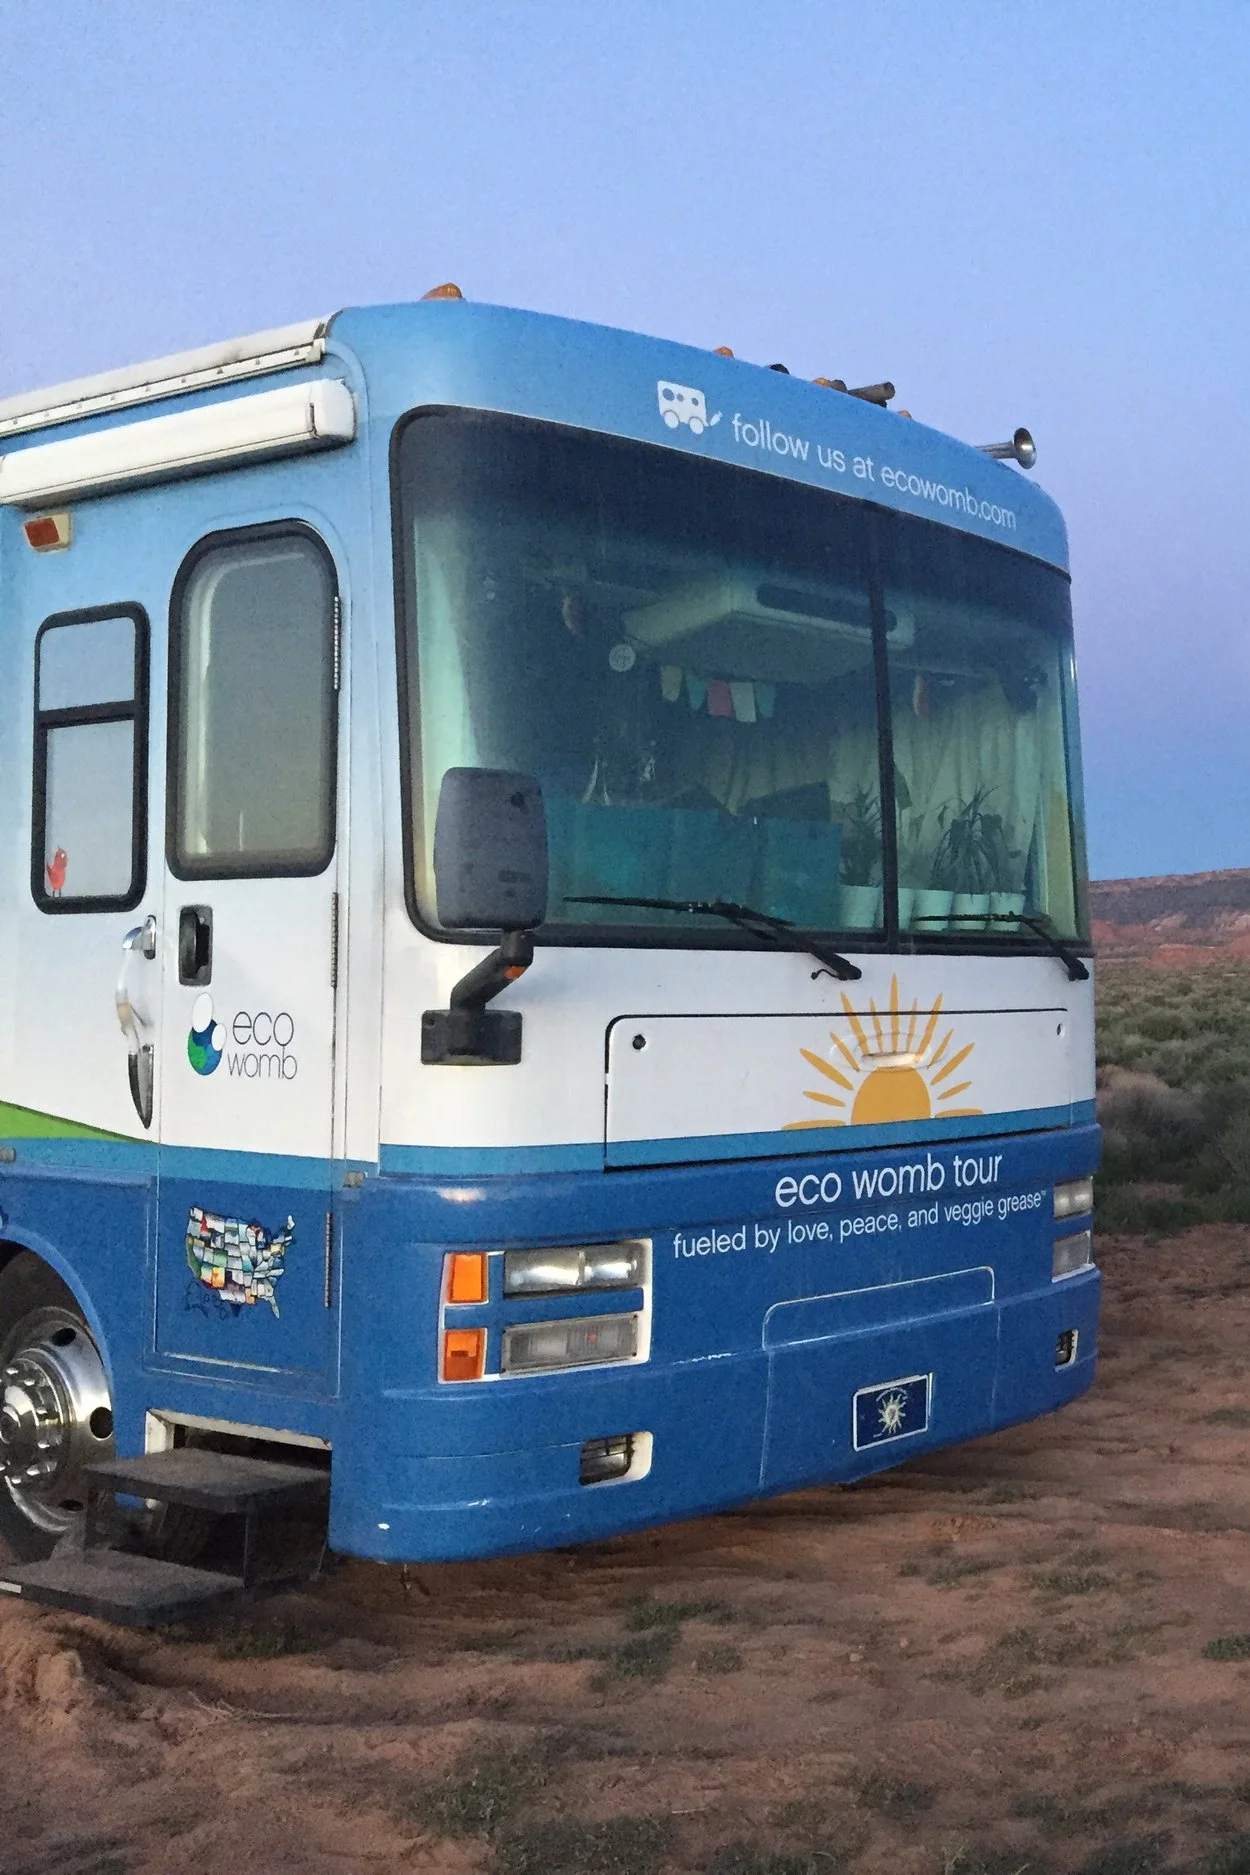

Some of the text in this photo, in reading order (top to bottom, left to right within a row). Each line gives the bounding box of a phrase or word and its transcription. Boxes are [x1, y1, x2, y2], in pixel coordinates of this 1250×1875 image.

[732, 413, 1017, 529] follow us at ecowomb.com
[232, 1011, 294, 1046] eco
[227, 1046, 297, 1080] womb
[775, 1153, 1003, 1208] eco womb tour
[673, 1226, 746, 1258] fueled
[755, 1224, 781, 1253] by
[788, 1219, 833, 1244] love,
[840, 1213, 902, 1243] peace,
[908, 1206, 938, 1227] and
[944, 1200, 994, 1226] veggie
